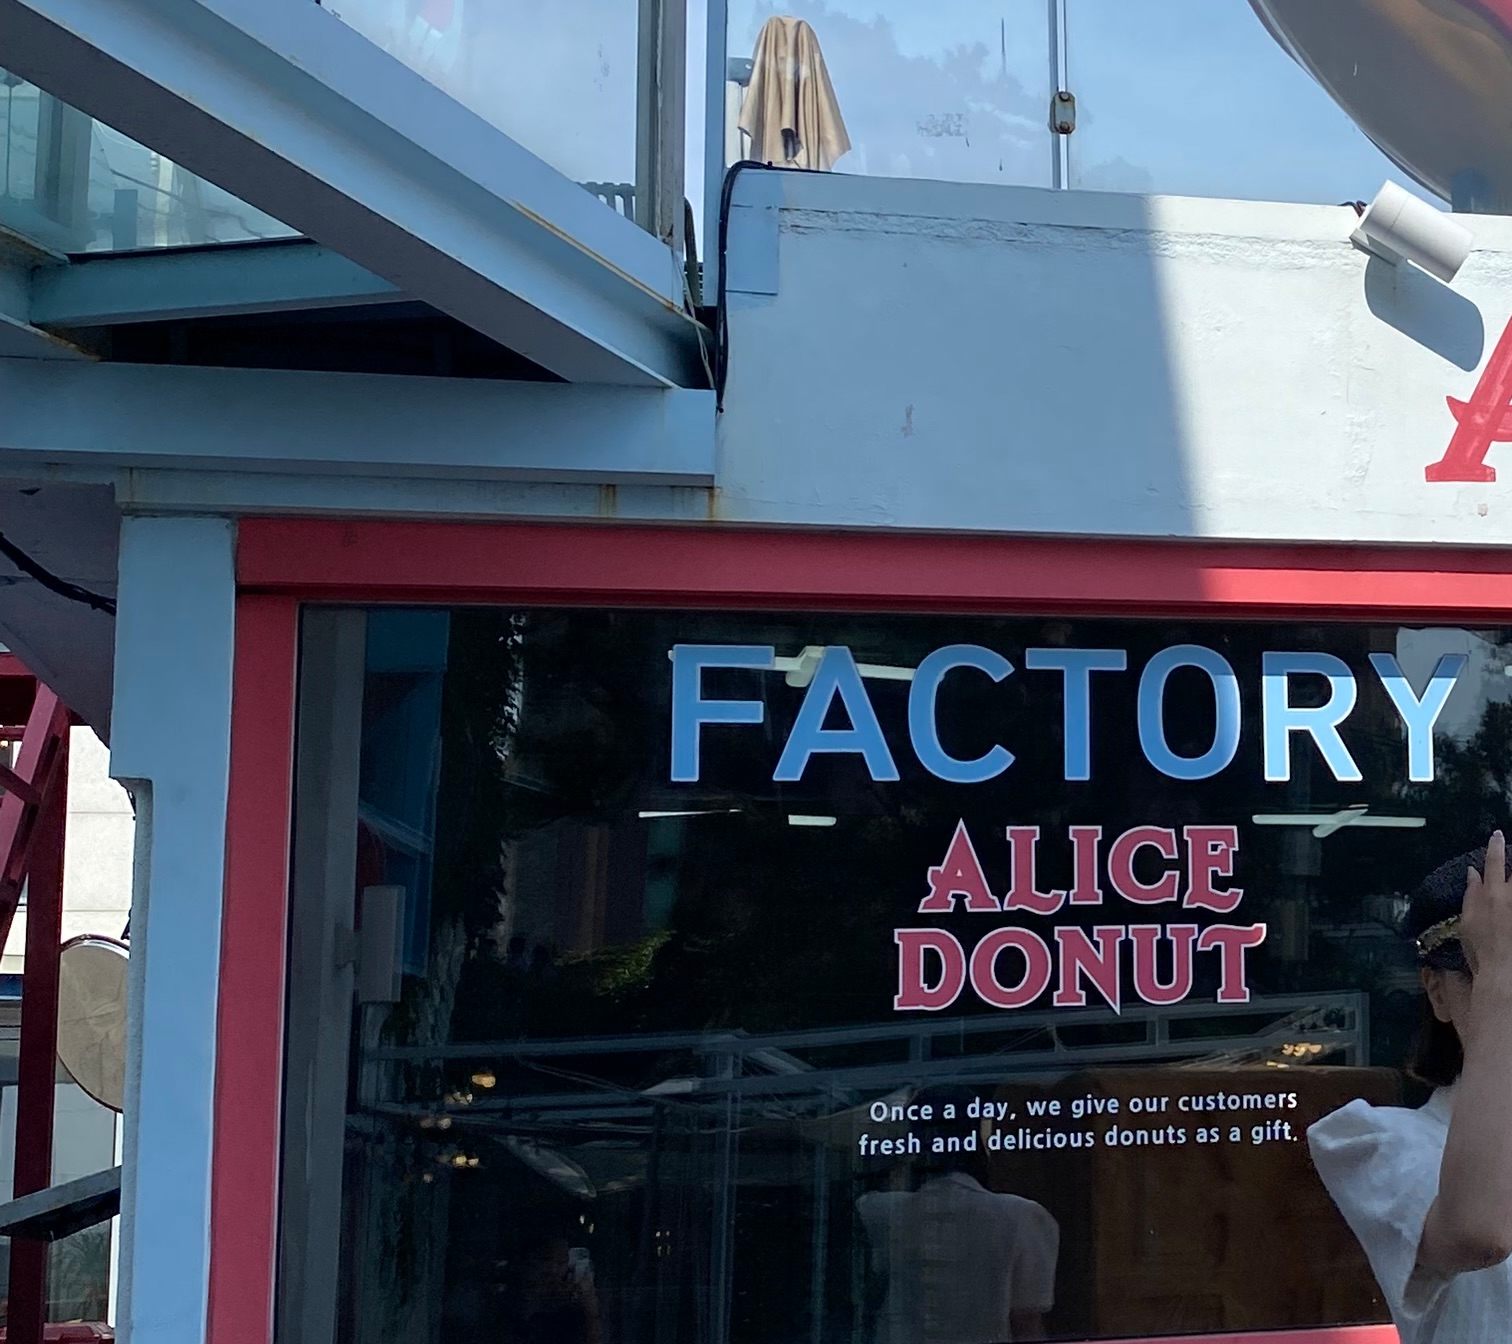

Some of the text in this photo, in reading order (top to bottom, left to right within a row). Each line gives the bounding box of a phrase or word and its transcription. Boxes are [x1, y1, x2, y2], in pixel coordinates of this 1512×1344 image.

[669, 643, 1470, 783] FACTORY
[917, 817, 1244, 916] ALICE
[893, 922, 1267, 1016] DONUT
[858, 1119, 1298, 1156] fresh and delicious donuts as a gift.
[870, 1091, 1298, 1122] Once a day, we give our customers
